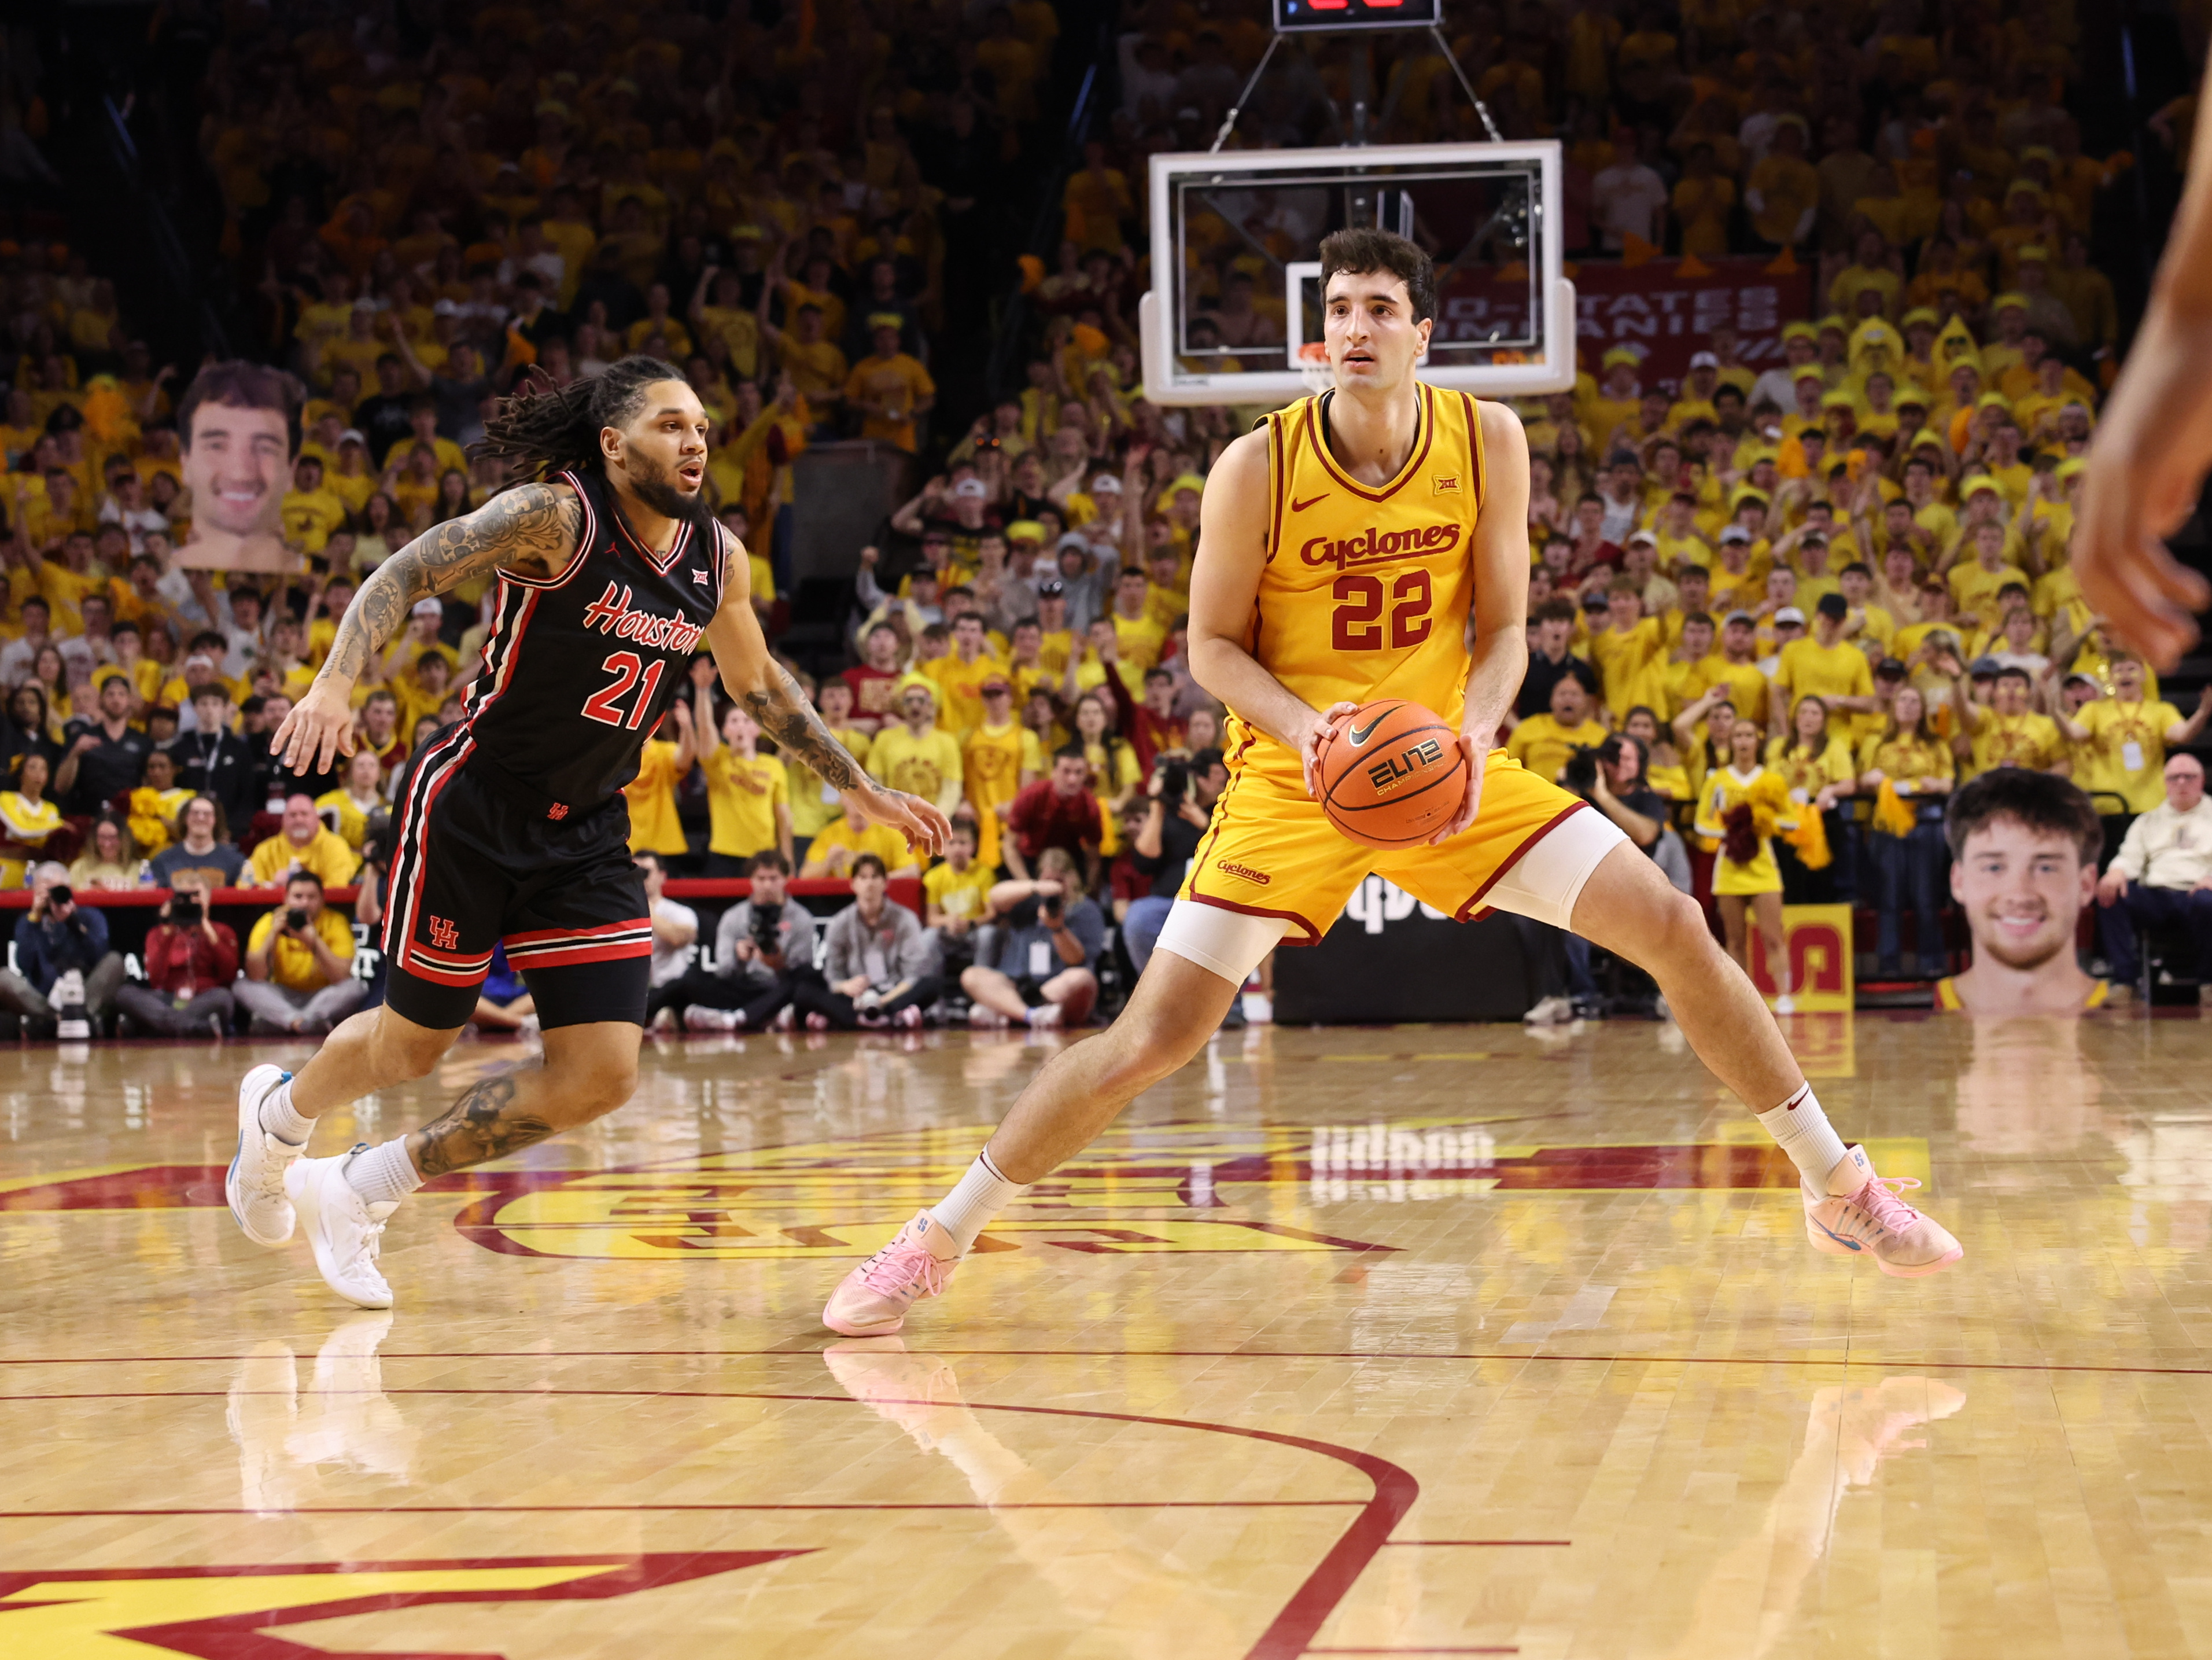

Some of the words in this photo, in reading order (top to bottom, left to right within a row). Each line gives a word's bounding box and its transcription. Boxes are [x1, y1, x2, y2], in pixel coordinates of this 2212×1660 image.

[1300, 524, 1461, 571] Cyclones
[583, 580, 705, 656] Houston
[1332, 569, 1433, 650] 22
[580, 650, 666, 730] 21
[1368, 738, 1444, 790] ELITE
[1217, 860, 1271, 885] Cyclones
[430, 915, 459, 949] UH
